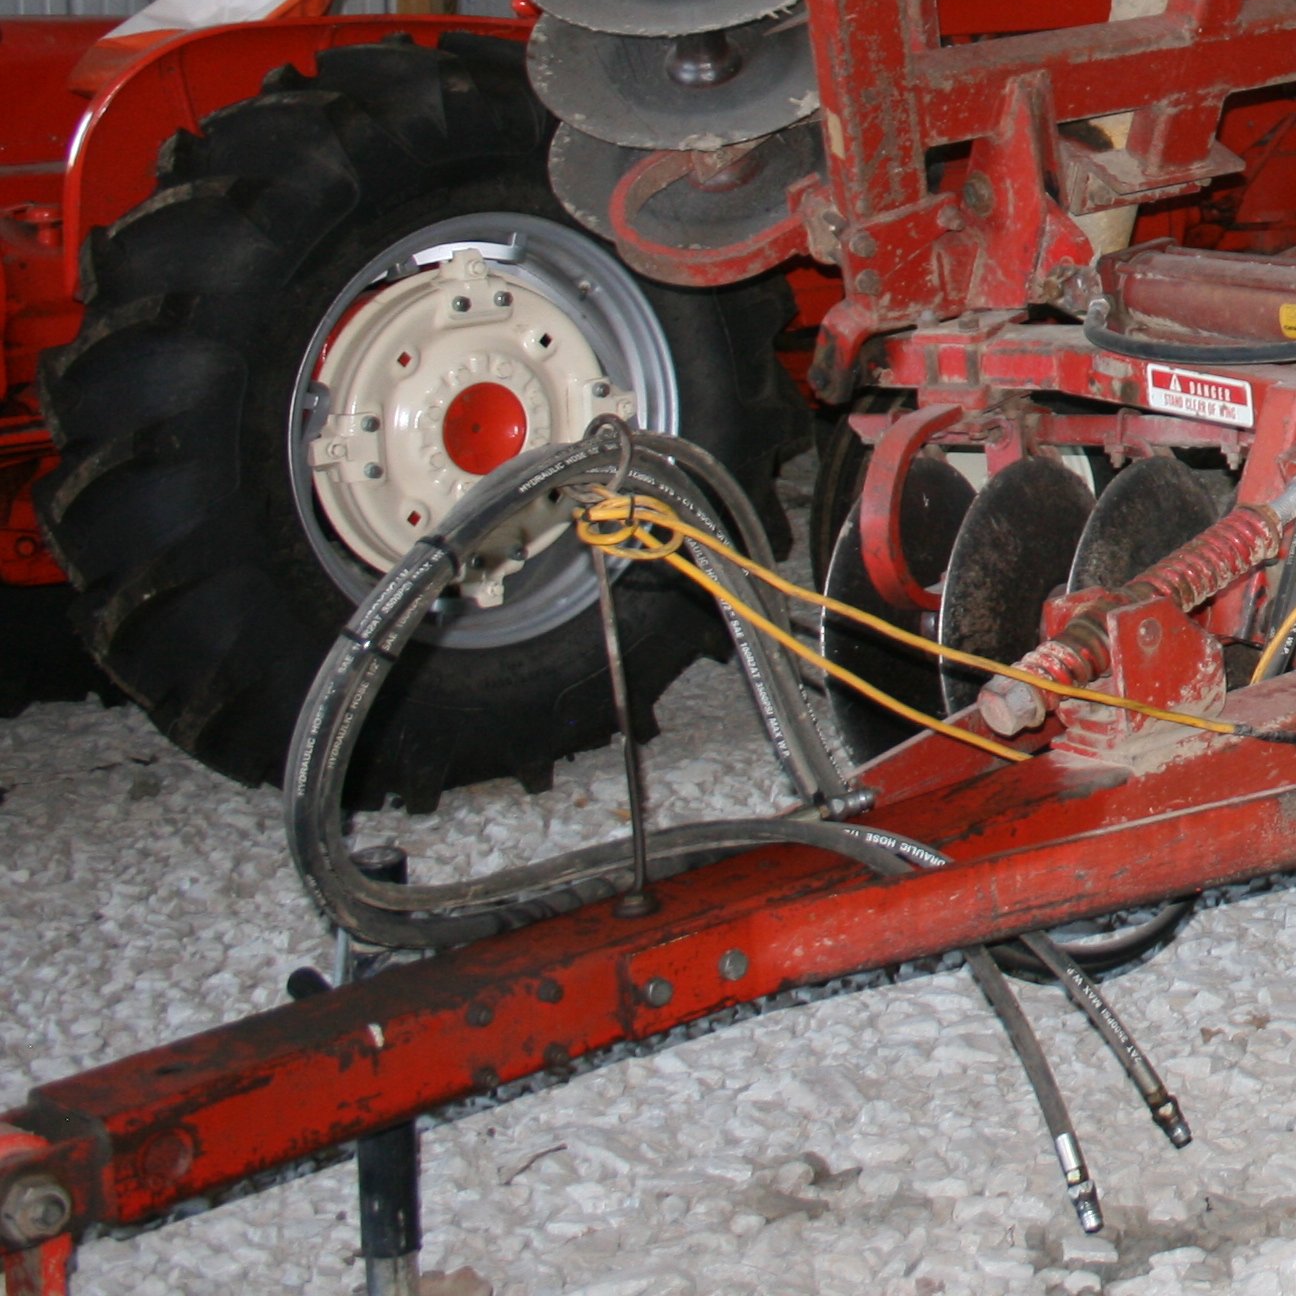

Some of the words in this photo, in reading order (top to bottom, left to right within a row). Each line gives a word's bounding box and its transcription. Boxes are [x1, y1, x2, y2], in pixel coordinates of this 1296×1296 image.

[1189, 380, 1232, 402] DANGER
[518, 462, 565, 494] HYDRAULIC
[327, 712, 354, 769] HYDRAULIC
[350, 680, 370, 710] HOSE
[296, 737, 316, 796] HYDRAULIC
[866, 832, 897, 848] HOSE
[1082, 985, 1103, 1009] MAX
